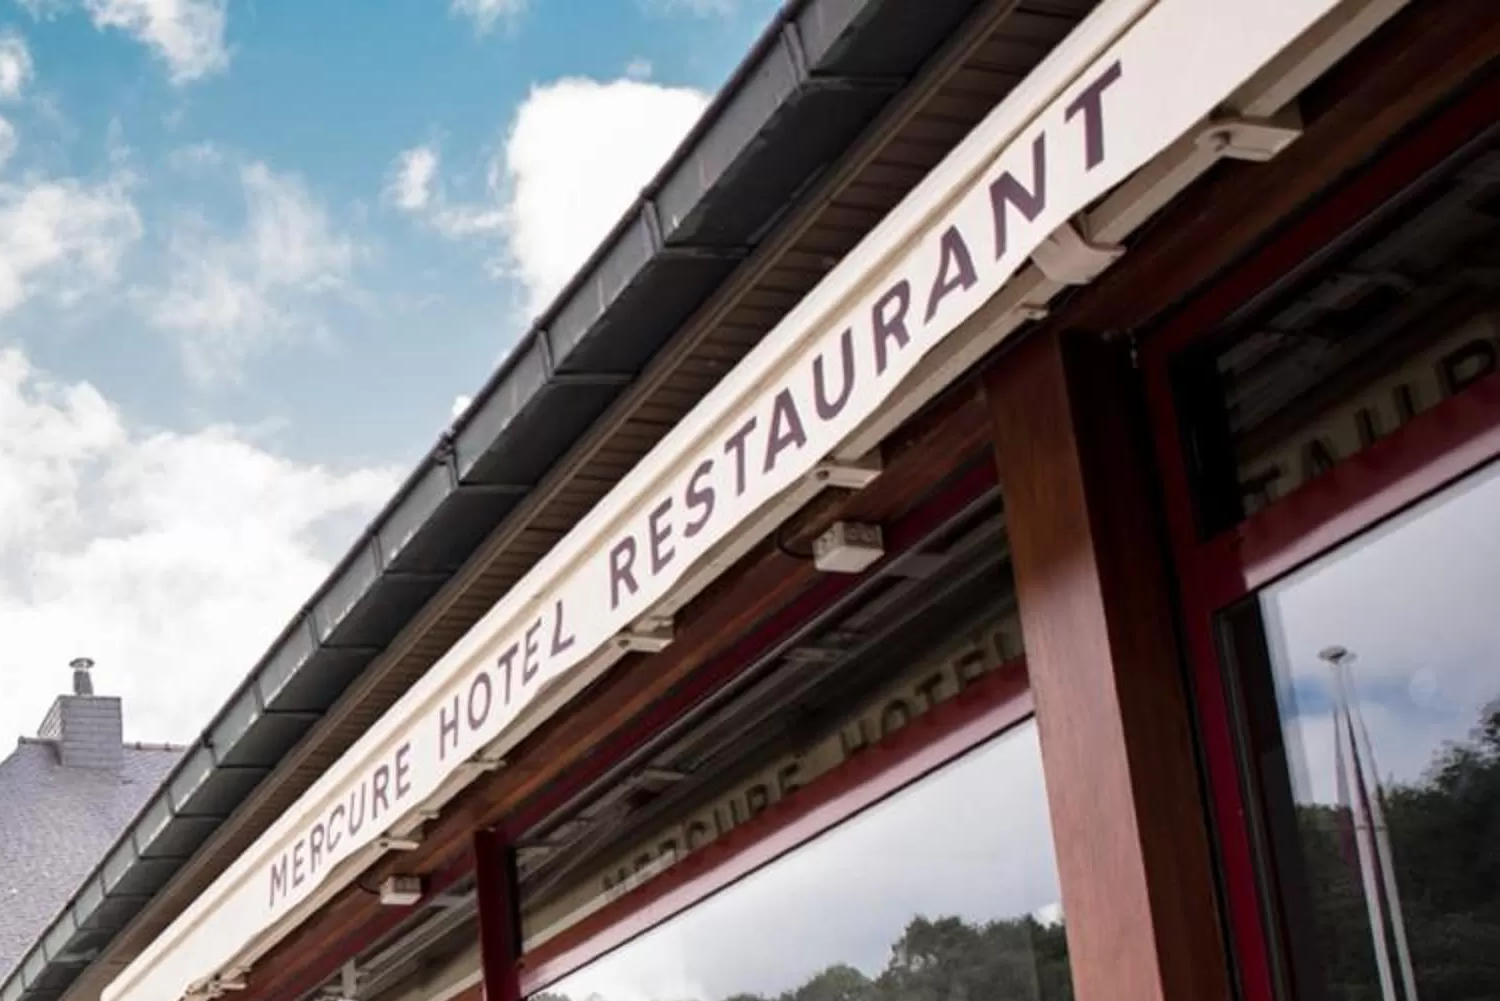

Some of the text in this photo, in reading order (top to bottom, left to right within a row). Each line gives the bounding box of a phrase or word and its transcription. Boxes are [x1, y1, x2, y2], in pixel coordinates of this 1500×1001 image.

[268, 60, 1122, 907] MERCURE HOTEL RESTAURANT
